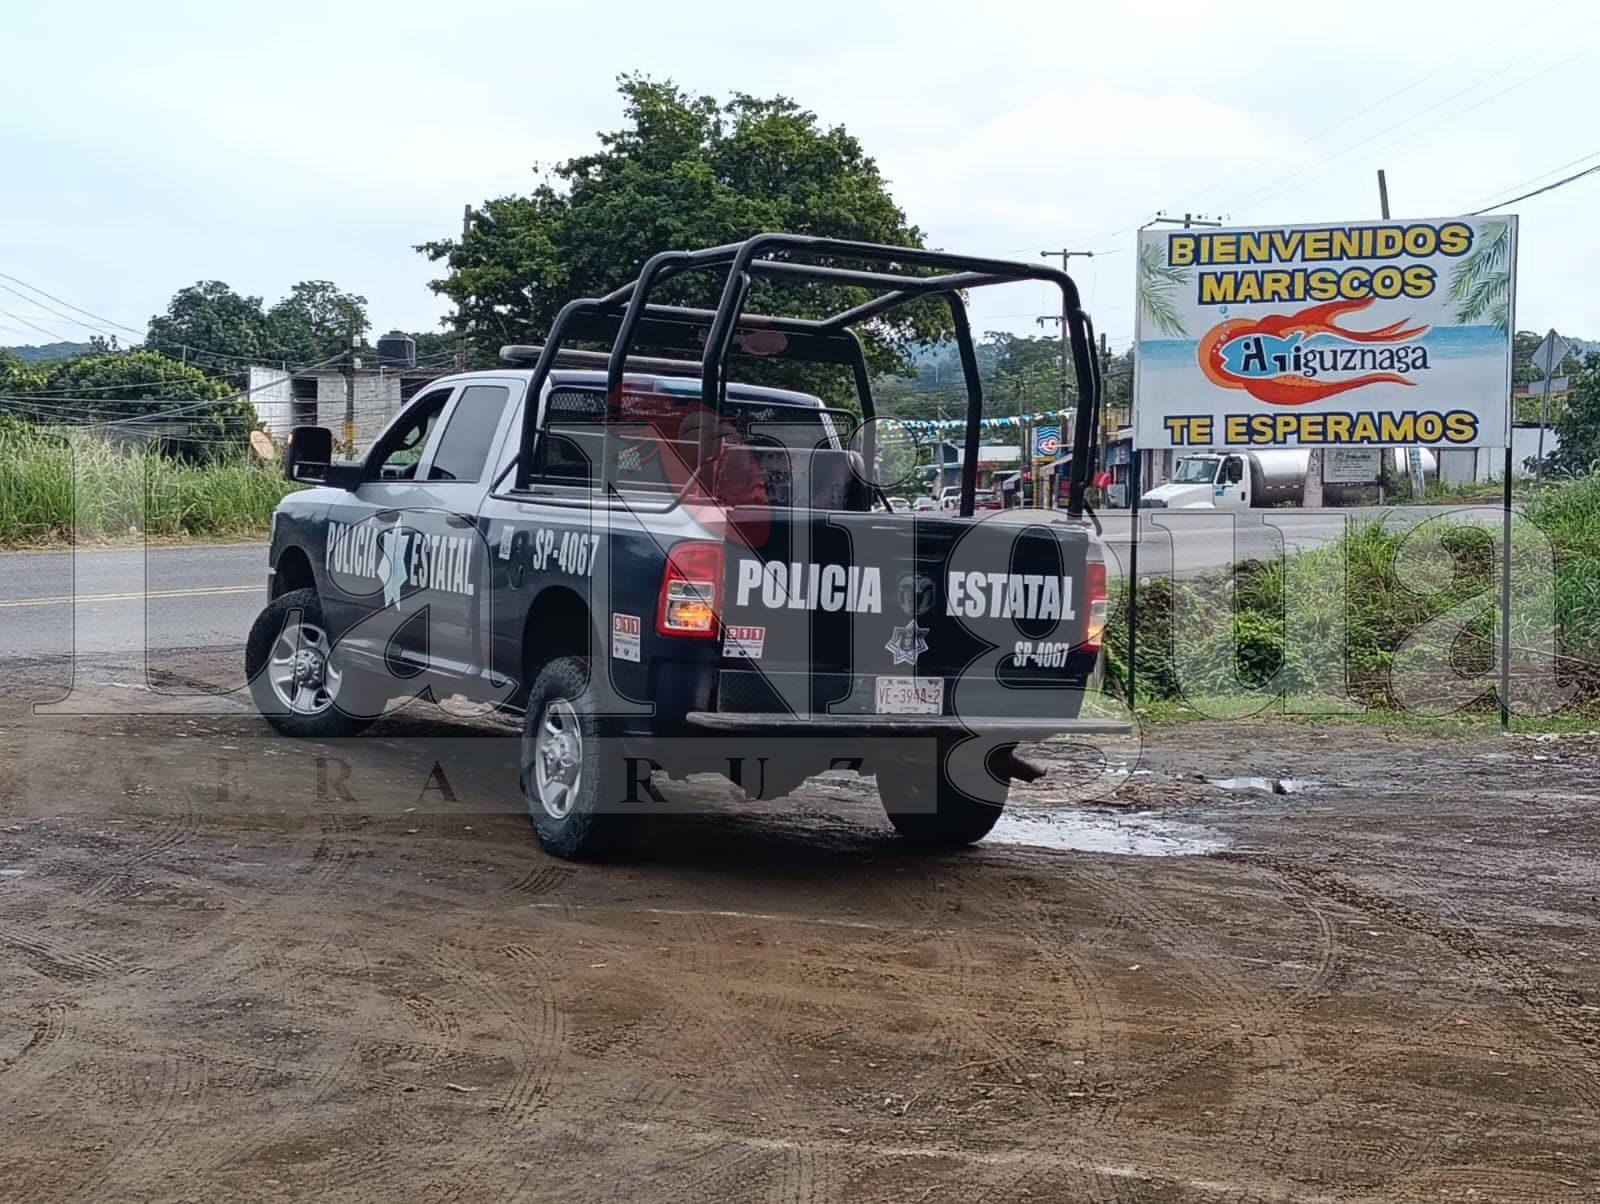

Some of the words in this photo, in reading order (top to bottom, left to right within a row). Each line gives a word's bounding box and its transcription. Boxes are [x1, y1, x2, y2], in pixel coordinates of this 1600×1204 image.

[1168, 222, 1474, 266] BIENVENIDOS
[1198, 264, 1437, 305] MARISCOS
[1164, 414, 1213, 445] TE
[1225, 410, 1479, 445] ESPERAMOS
[410, 533, 474, 596] ESTATAL
[533, 528, 600, 577] SP-4067
[736, 559, 882, 614] POLICIA
[946, 571, 1075, 620] ESTATAL
[614, 615, 639, 634] 911
[726, 626, 763, 640] 911
[1013, 641, 1069, 668] SP-4067
